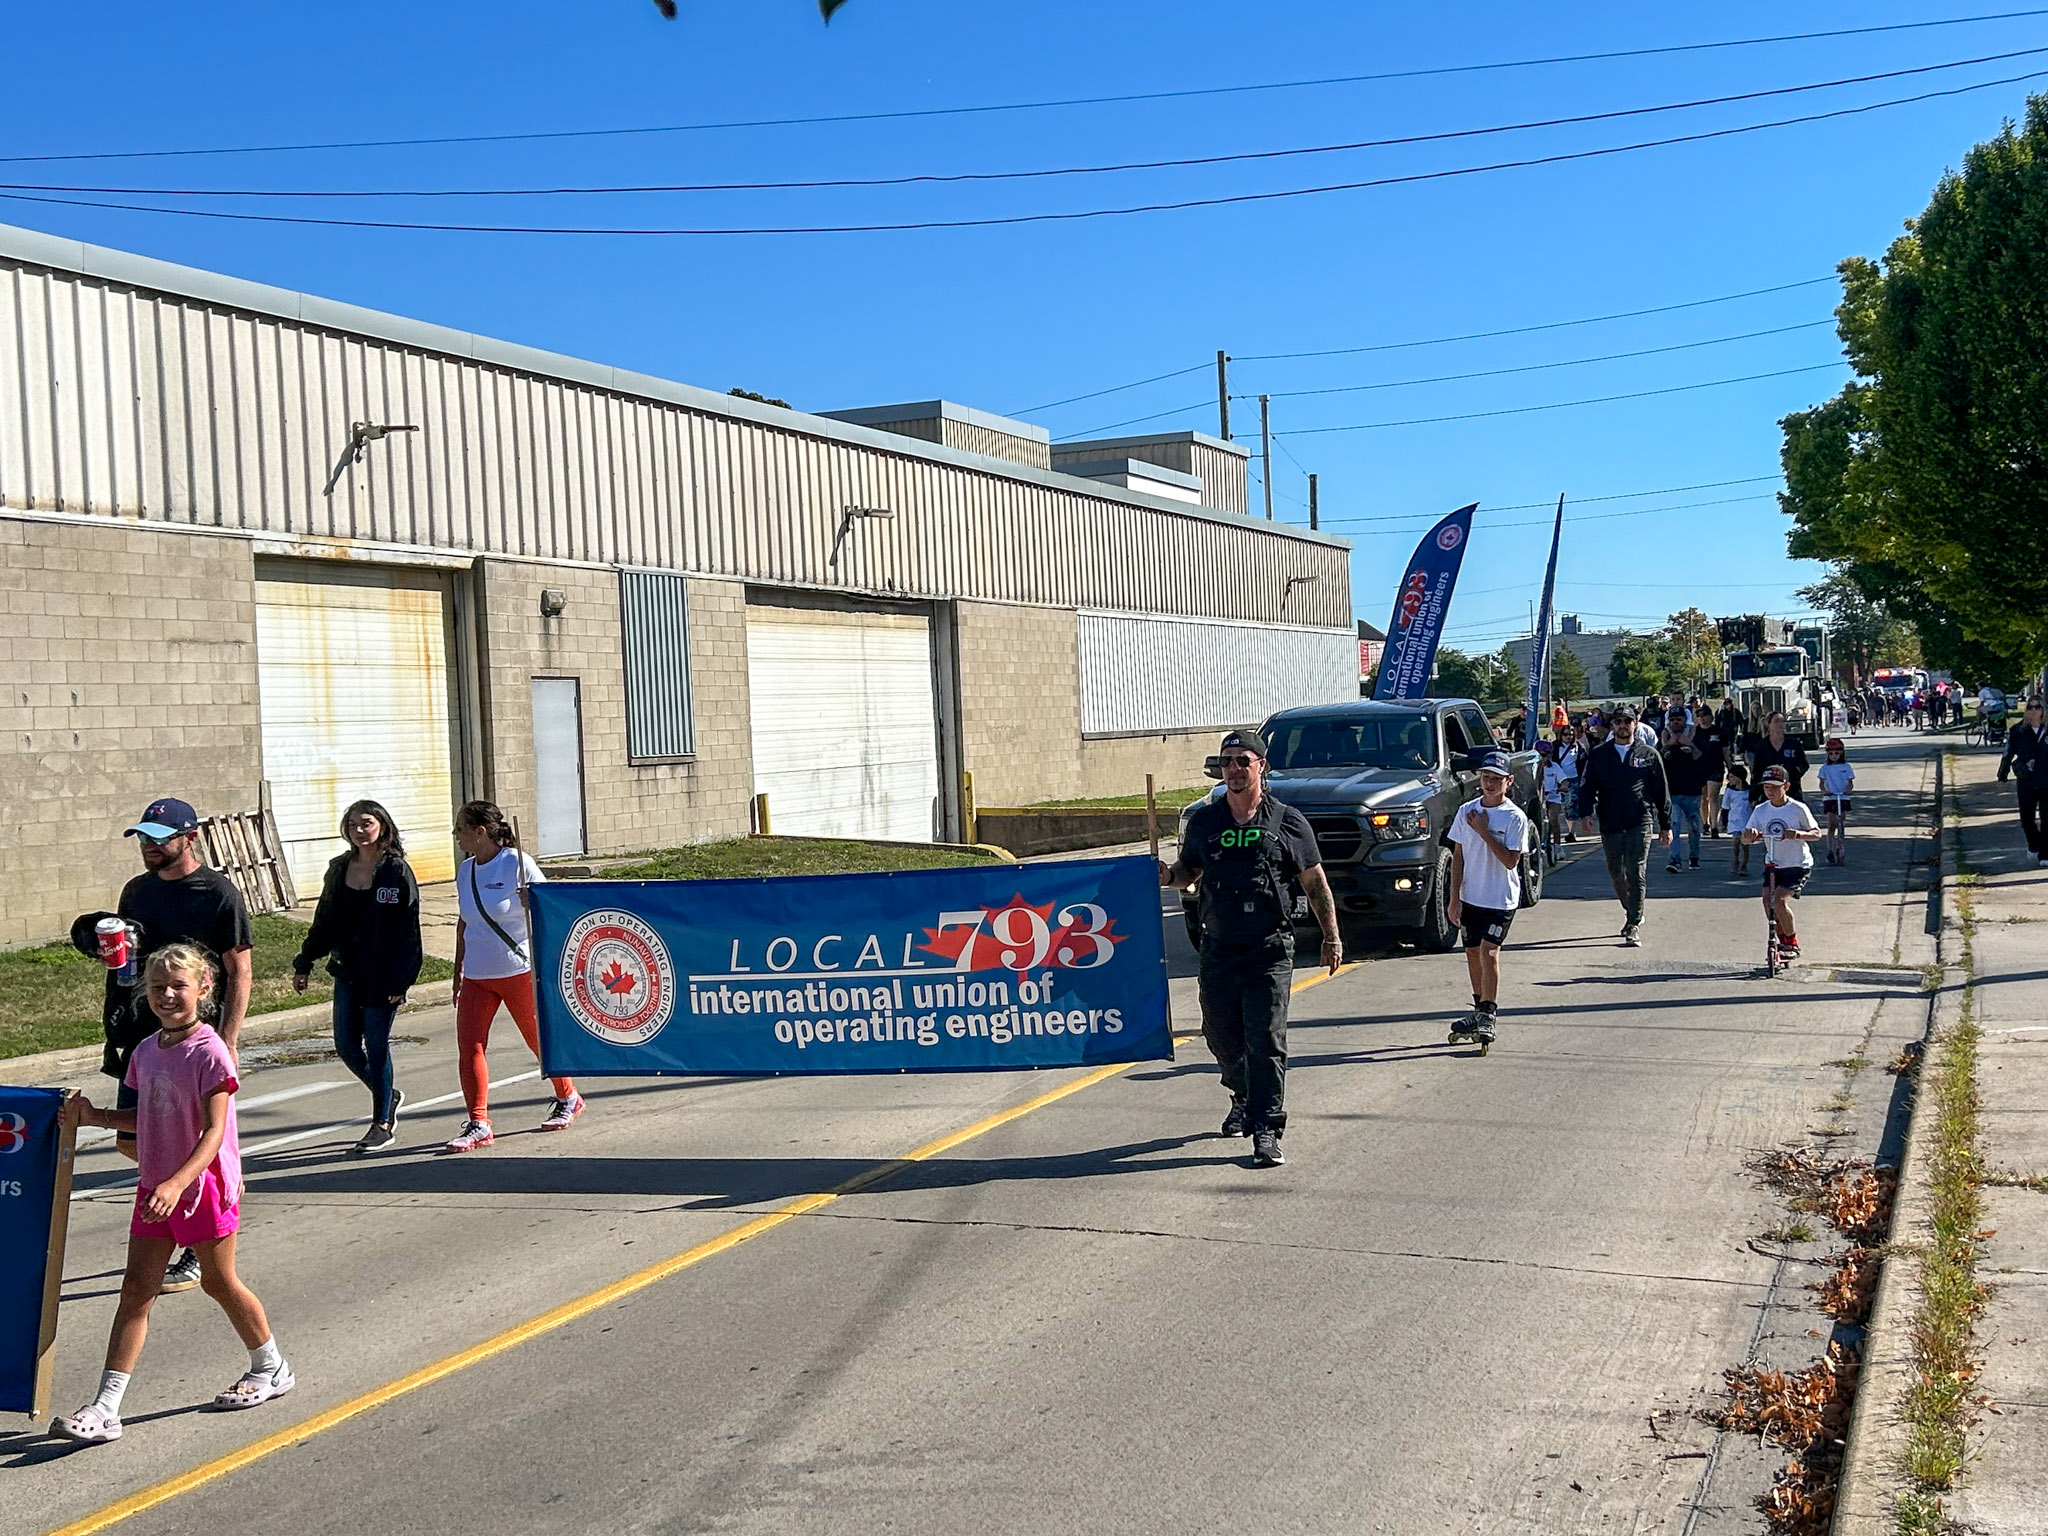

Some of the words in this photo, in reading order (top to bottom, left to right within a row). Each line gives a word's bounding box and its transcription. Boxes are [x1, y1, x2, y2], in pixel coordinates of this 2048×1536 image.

[1383, 627, 1408, 694] LOCAL
[1398, 572, 1428, 624] 793
[1396, 636, 1419, 700] ternational
[1412, 603, 1429, 635] union
[1424, 590, 1433, 601] of
[1411, 629, 1435, 684] operating
[1426, 571, 1449, 627] engineers
[1220, 829, 1260, 847] GIP
[377, 887, 399, 903] OE
[573, 918, 596, 943] UNION
[599, 914, 614, 924] OF
[730, 933, 925, 972] LOCAL
[938, 903, 1115, 971] 793
[617, 916, 669, 971] OPERATING
[622, 932, 654, 966] NUNAVUT
[563, 947, 606, 1036] INTERNATIONAL
[577, 984, 601, 1020] GROWING
[601, 1016, 639, 1029] STRONGER
[639, 985, 660, 1020] TOGETHER
[613, 1005, 629, 1016] 793
[639, 976, 671, 1037] ENGINEERS
[689, 978, 904, 1014] international
[912, 976, 1009, 1009] union
[1018, 971, 1054, 1005] of
[774, 1010, 940, 1049] operating
[945, 1005, 1124, 1044] engineers
